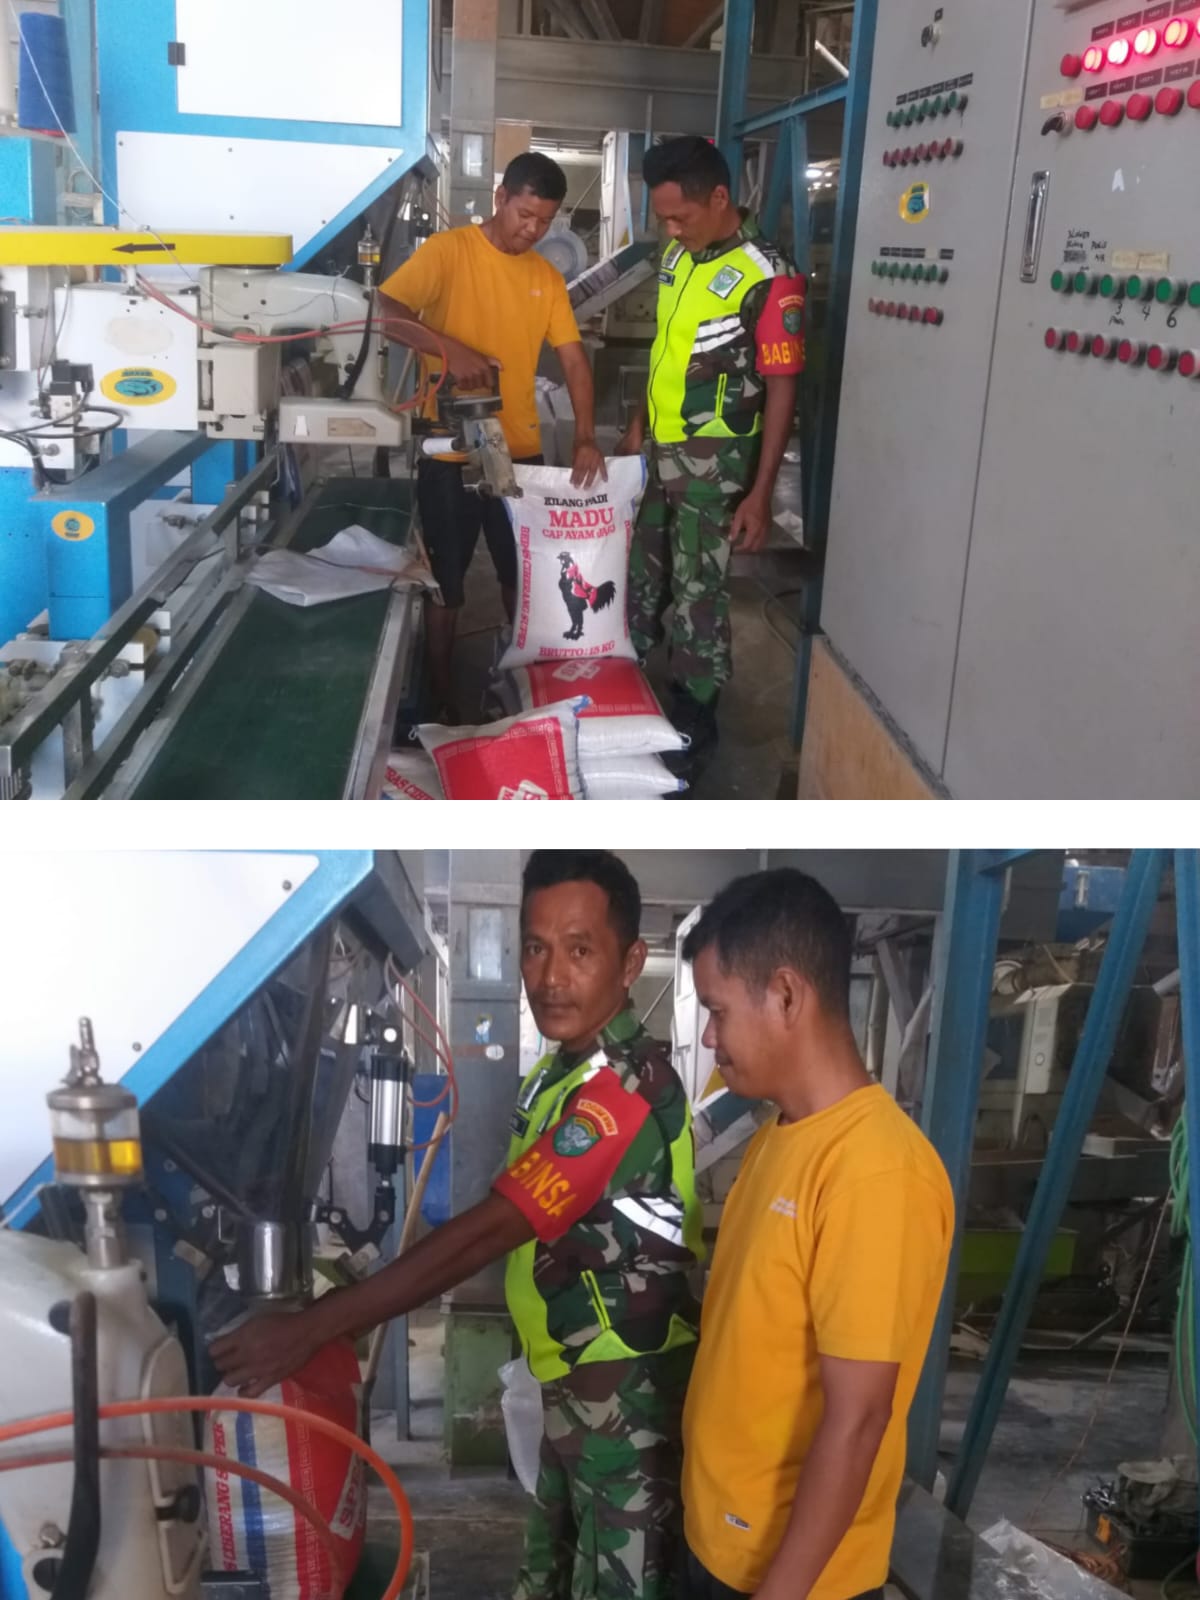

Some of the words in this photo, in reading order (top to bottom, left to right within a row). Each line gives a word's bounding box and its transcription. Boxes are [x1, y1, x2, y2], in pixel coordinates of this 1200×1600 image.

[1166, 306, 1178, 329] 6
[544, 496, 584, 507] KILANG
[584, 493, 608, 507] PADI
[549, 506, 614, 529] MADU
[542, 528, 563, 540] CAP
[565, 529, 595, 541] AYAM
[601, 640, 616, 653] KG
[212, 1423, 229, 1480] SPER
